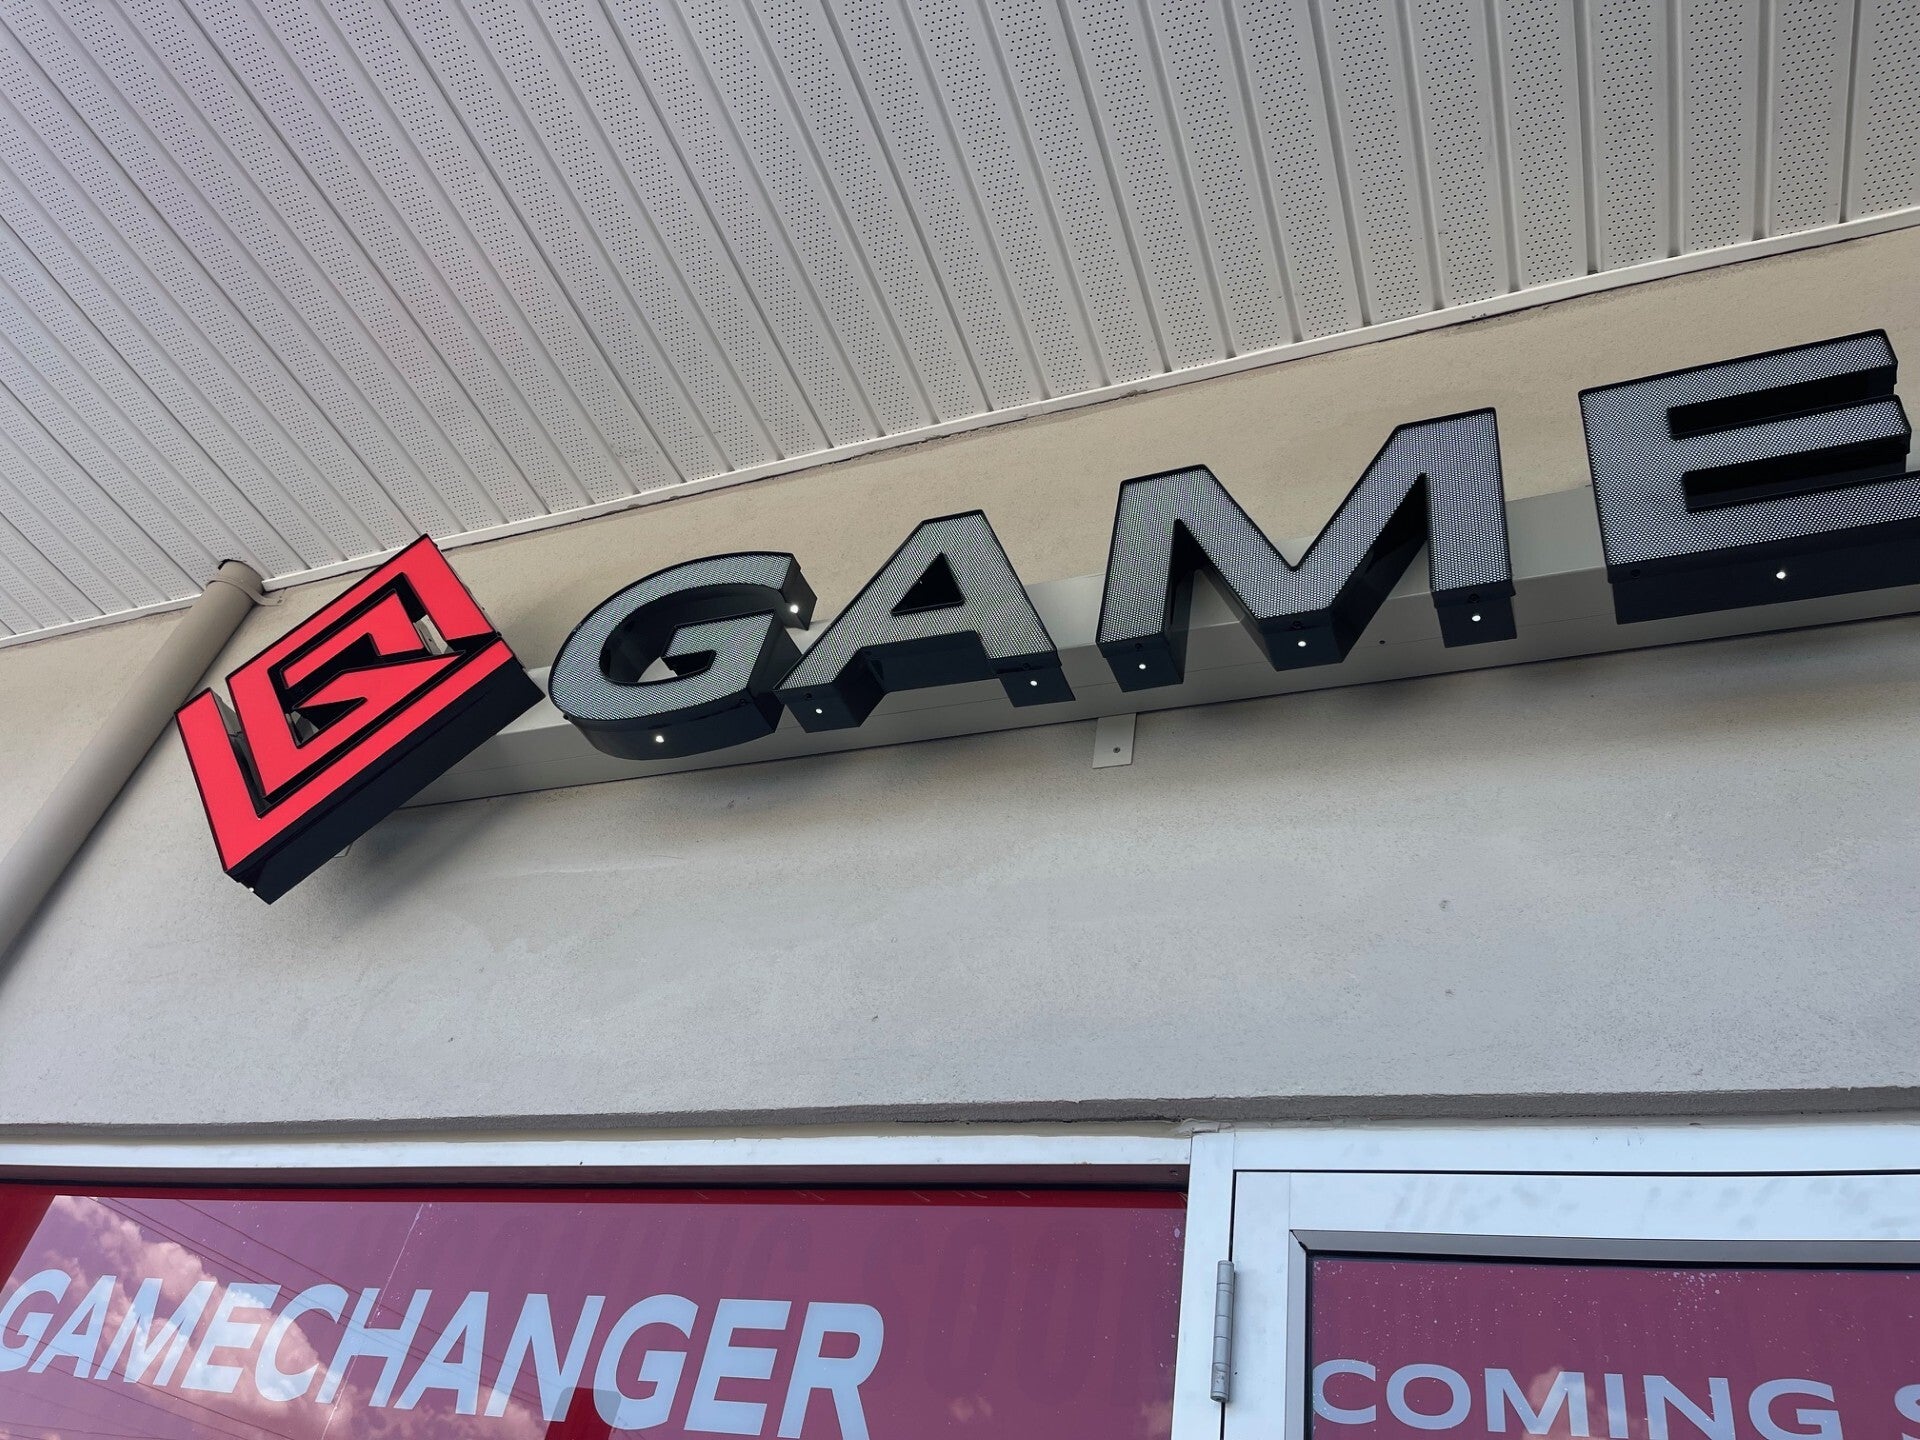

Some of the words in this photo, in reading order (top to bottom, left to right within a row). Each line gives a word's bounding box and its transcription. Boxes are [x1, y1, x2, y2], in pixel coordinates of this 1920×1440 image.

[549, 329, 1920, 745] GAME
[0, 1269, 884, 1440] GAMECHANGER
[1312, 1358, 1844, 1440] COMING
